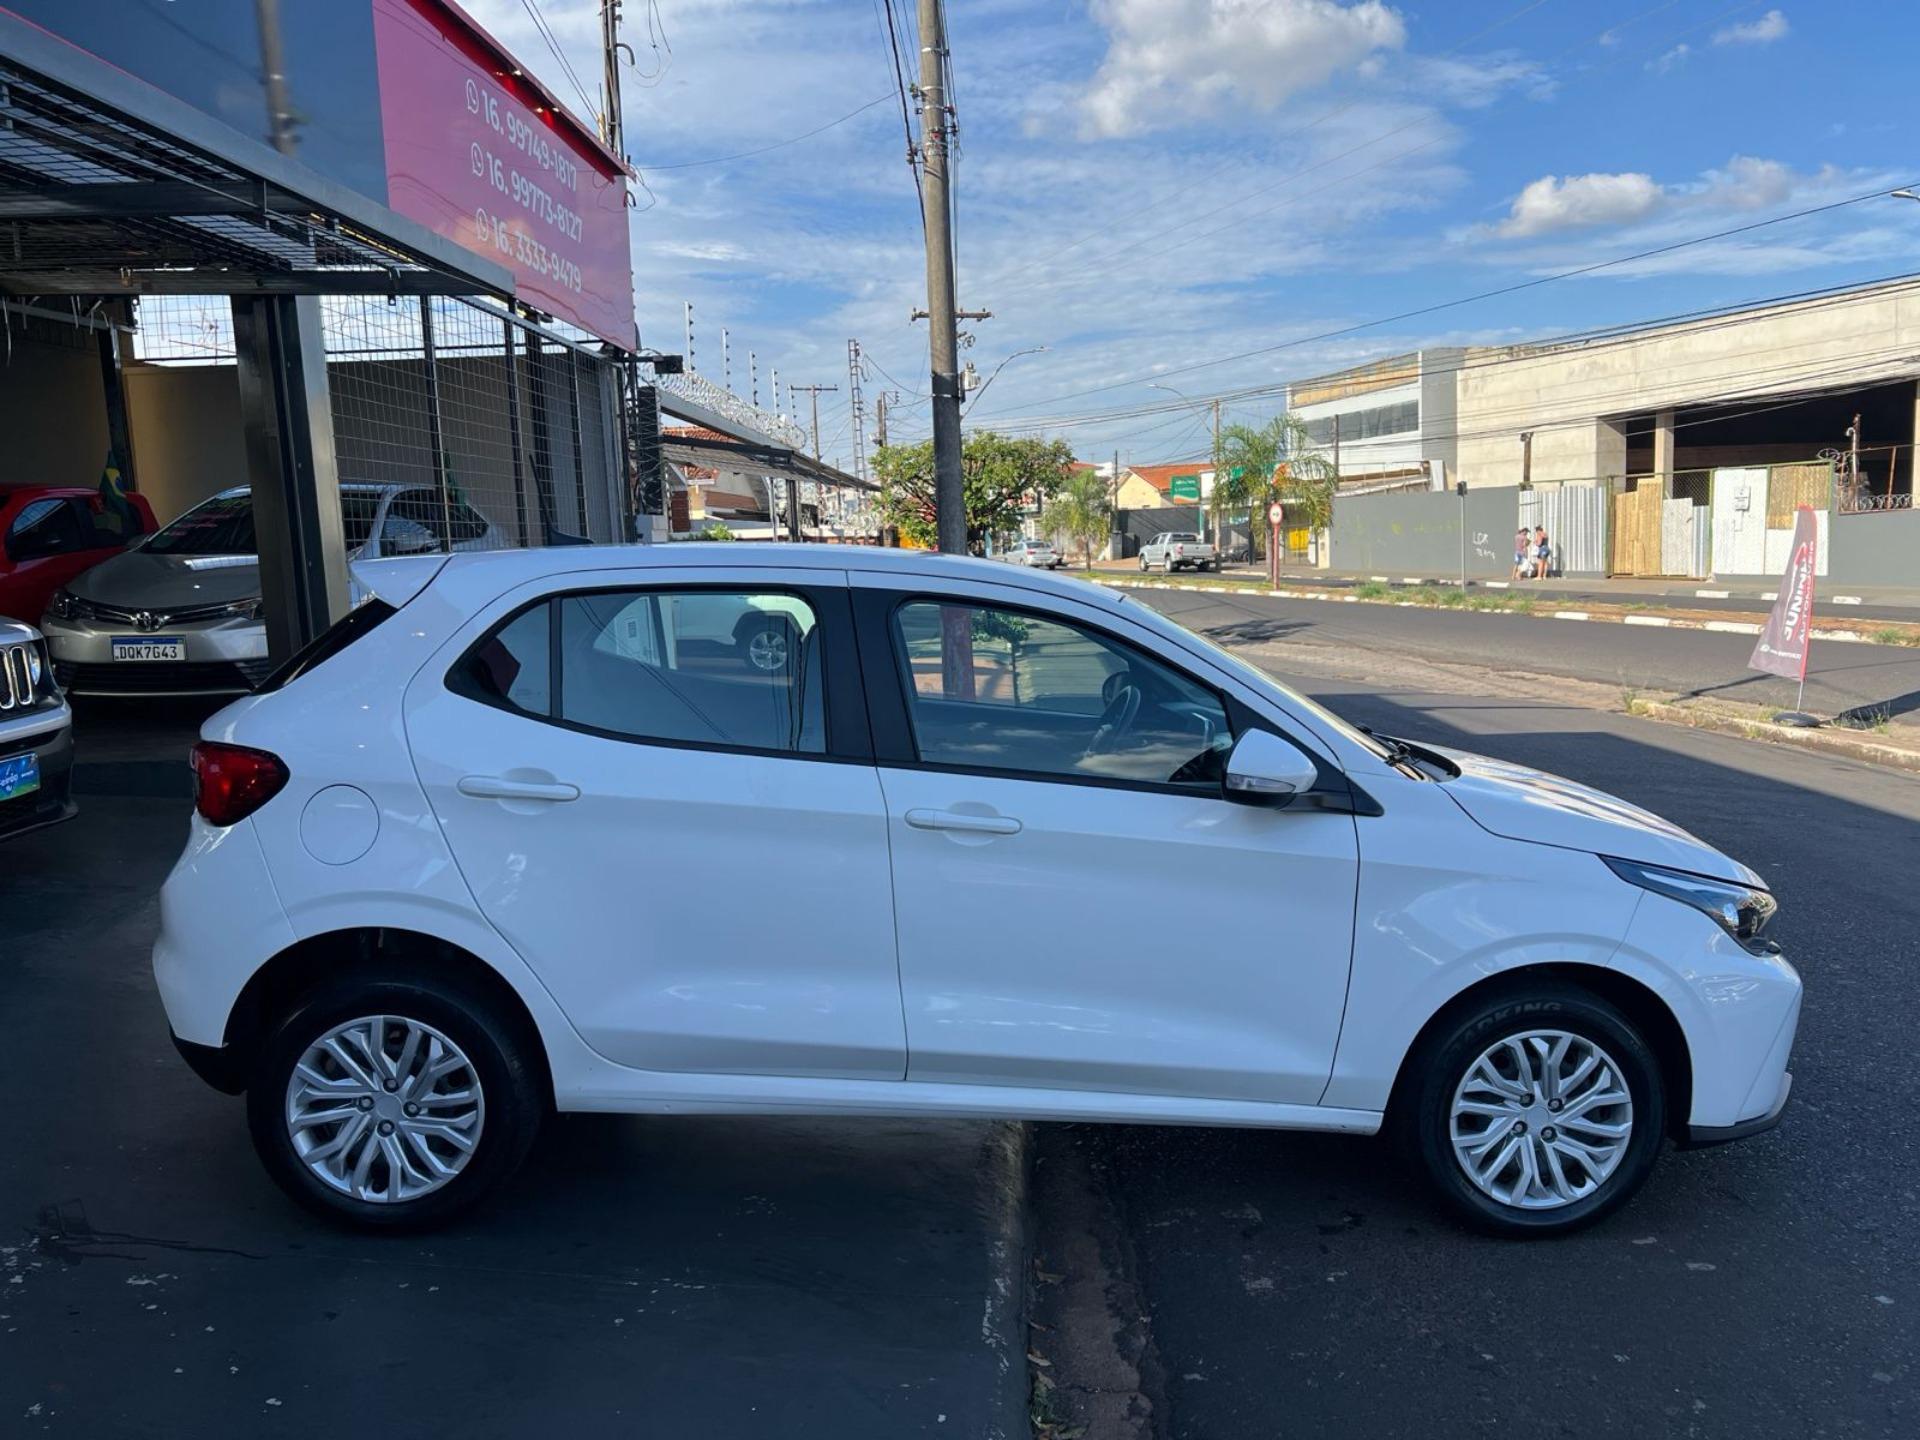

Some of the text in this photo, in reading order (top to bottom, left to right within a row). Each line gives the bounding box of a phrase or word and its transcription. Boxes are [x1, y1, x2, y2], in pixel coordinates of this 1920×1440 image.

[481, 89, 504, 136] 16.
[486, 151, 583, 243] 16. 99773-8127
[491, 215, 513, 257] 16.
